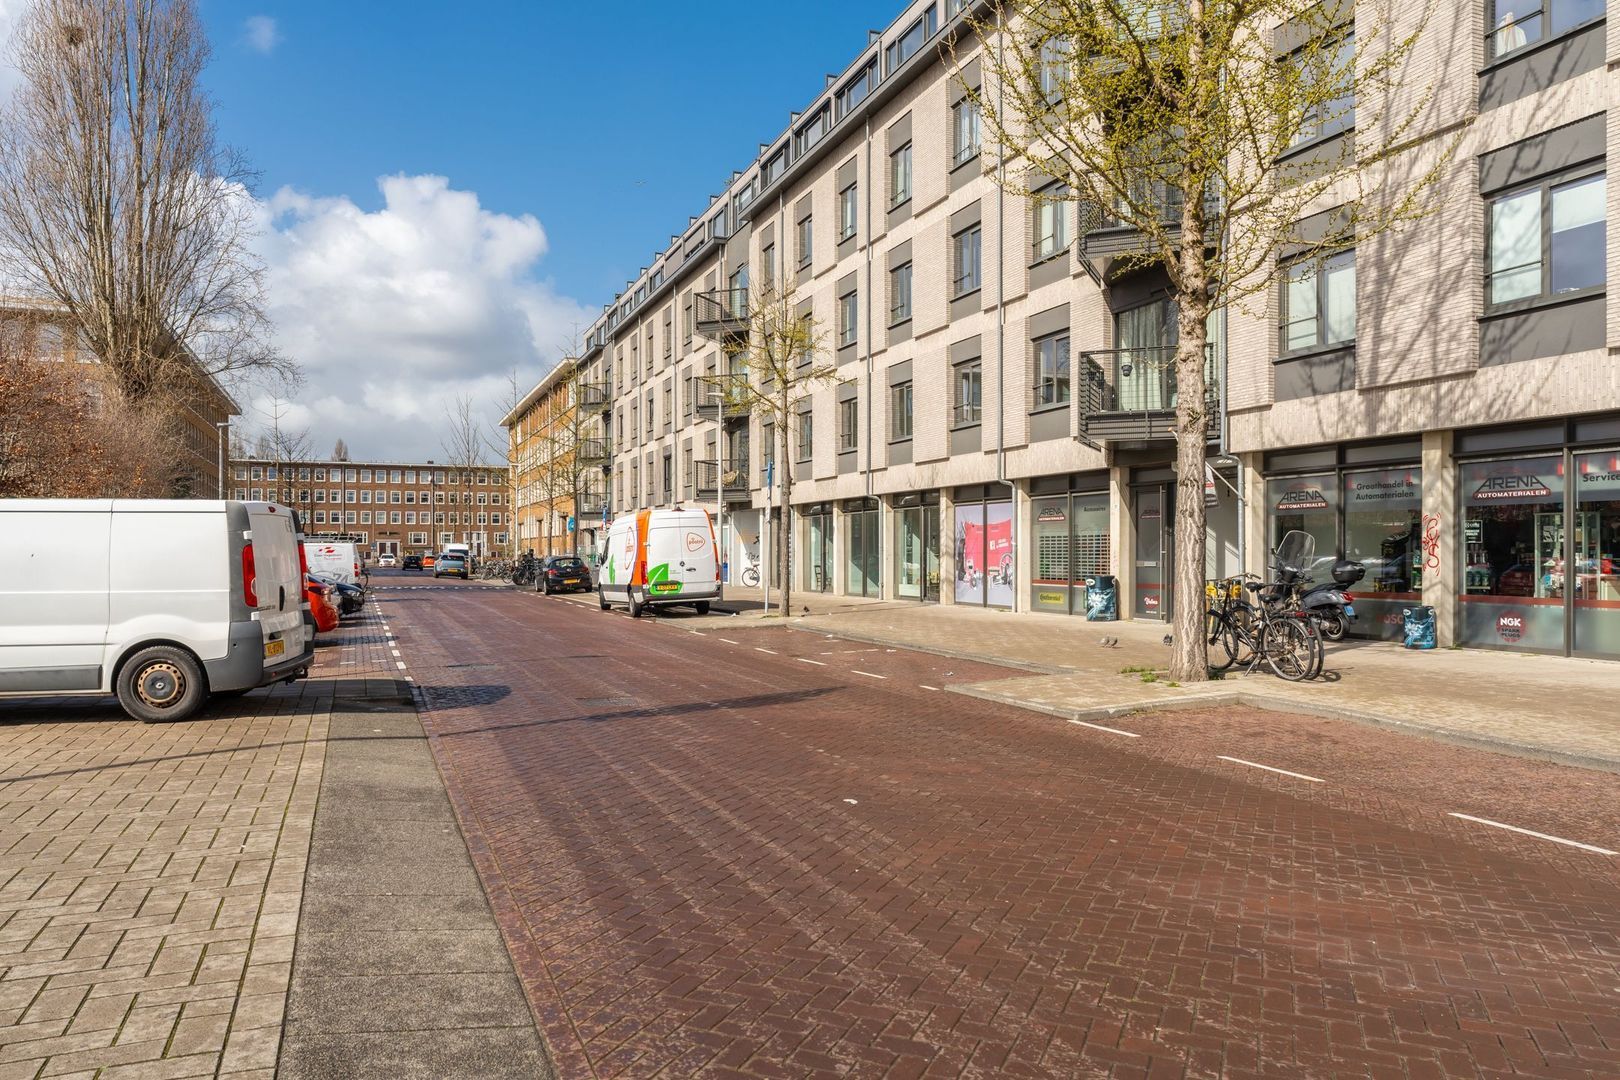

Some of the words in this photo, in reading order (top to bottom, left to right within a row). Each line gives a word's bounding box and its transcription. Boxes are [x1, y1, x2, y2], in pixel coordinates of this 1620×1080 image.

[1357, 480, 1403, 490] Groothandel
[1475, 475, 1548, 493] ARENA
[1279, 490, 1327, 504] ARENA
[1356, 490, 1414, 500] Automaterialen
[1477, 490, 1547, 499] AUTOMATERIALEN
[1500, 617, 1521, 627] NGK
